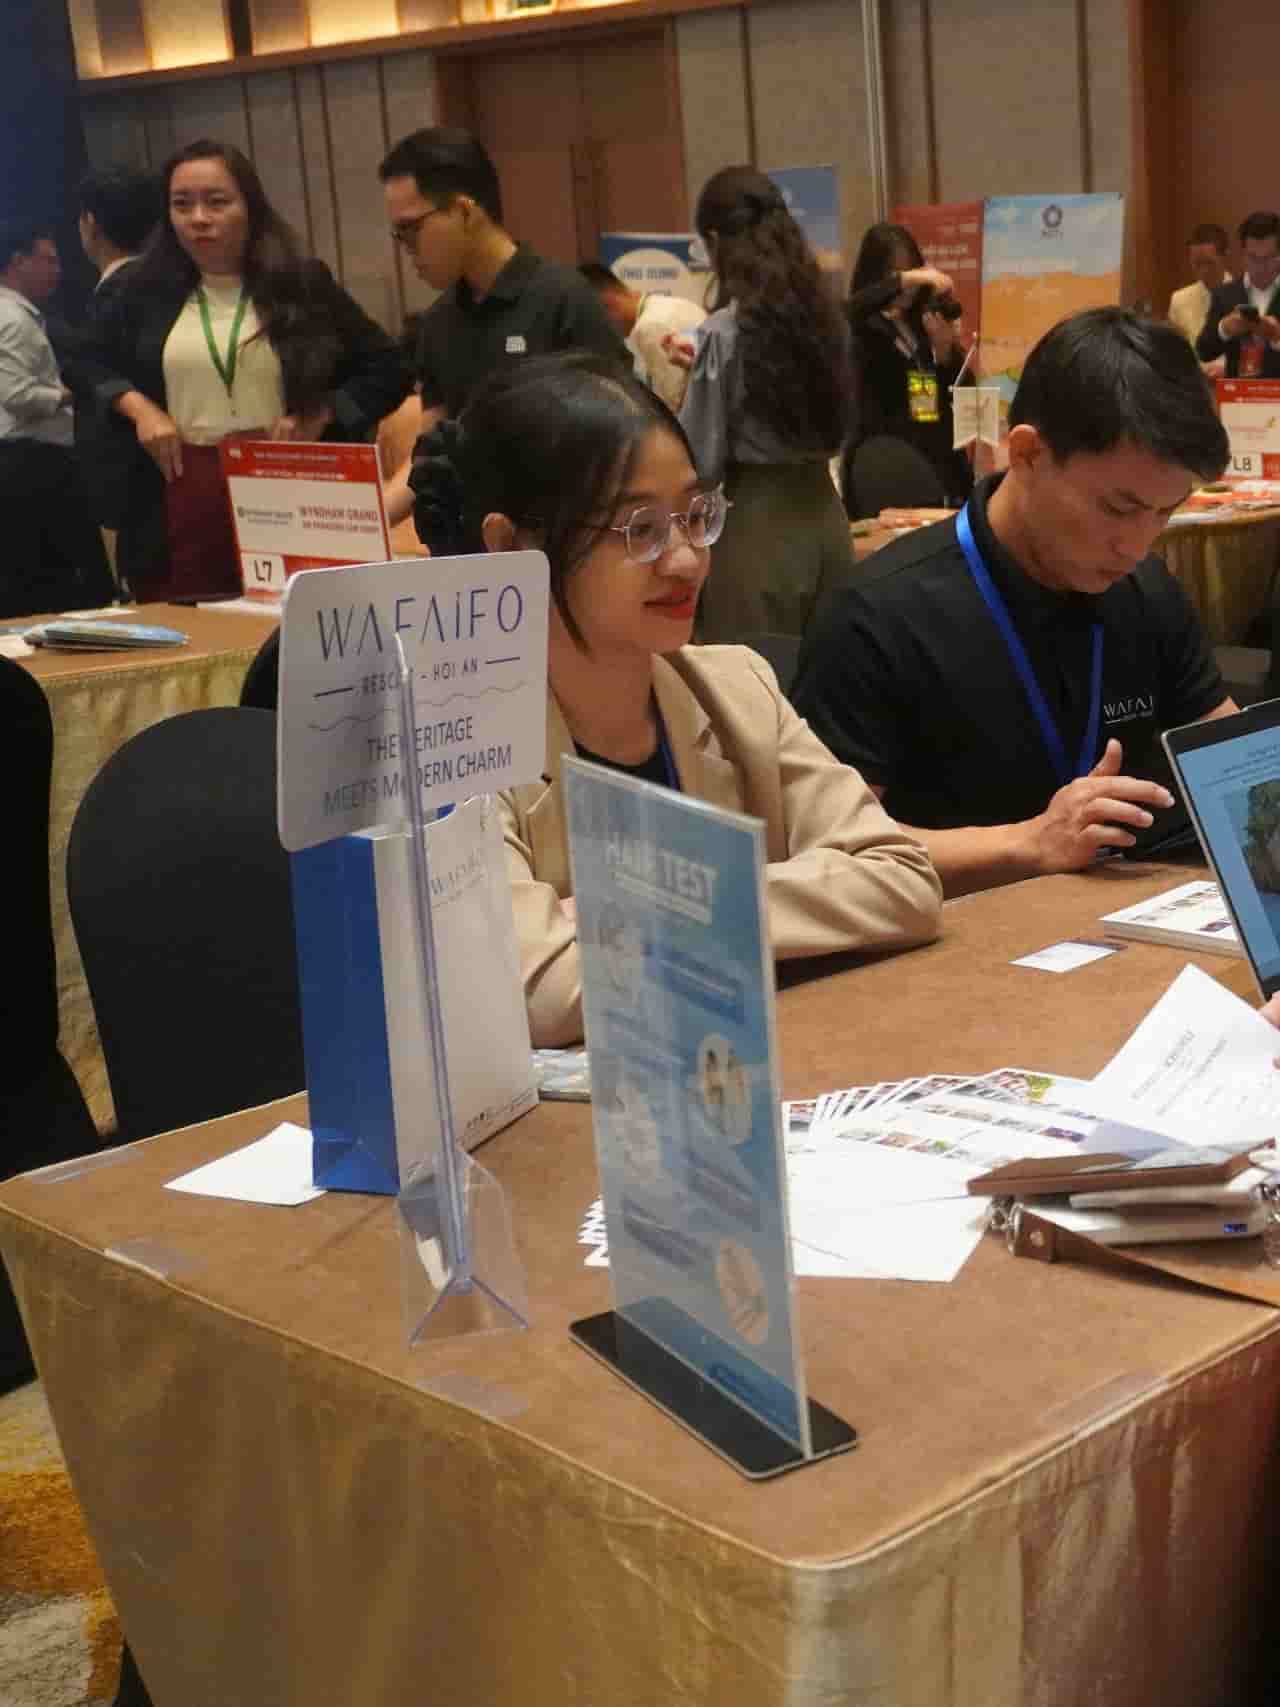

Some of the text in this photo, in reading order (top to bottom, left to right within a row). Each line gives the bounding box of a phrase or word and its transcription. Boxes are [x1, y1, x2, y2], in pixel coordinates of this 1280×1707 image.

[254, 559, 272, 582] L7
[462, 656, 478, 675] AN
[367, 715, 473, 762] THE ERITAGE
[324, 776, 378, 817] MEETS
[456, 744, 512, 778] CHARM
[658, 848, 719, 904] TEST
